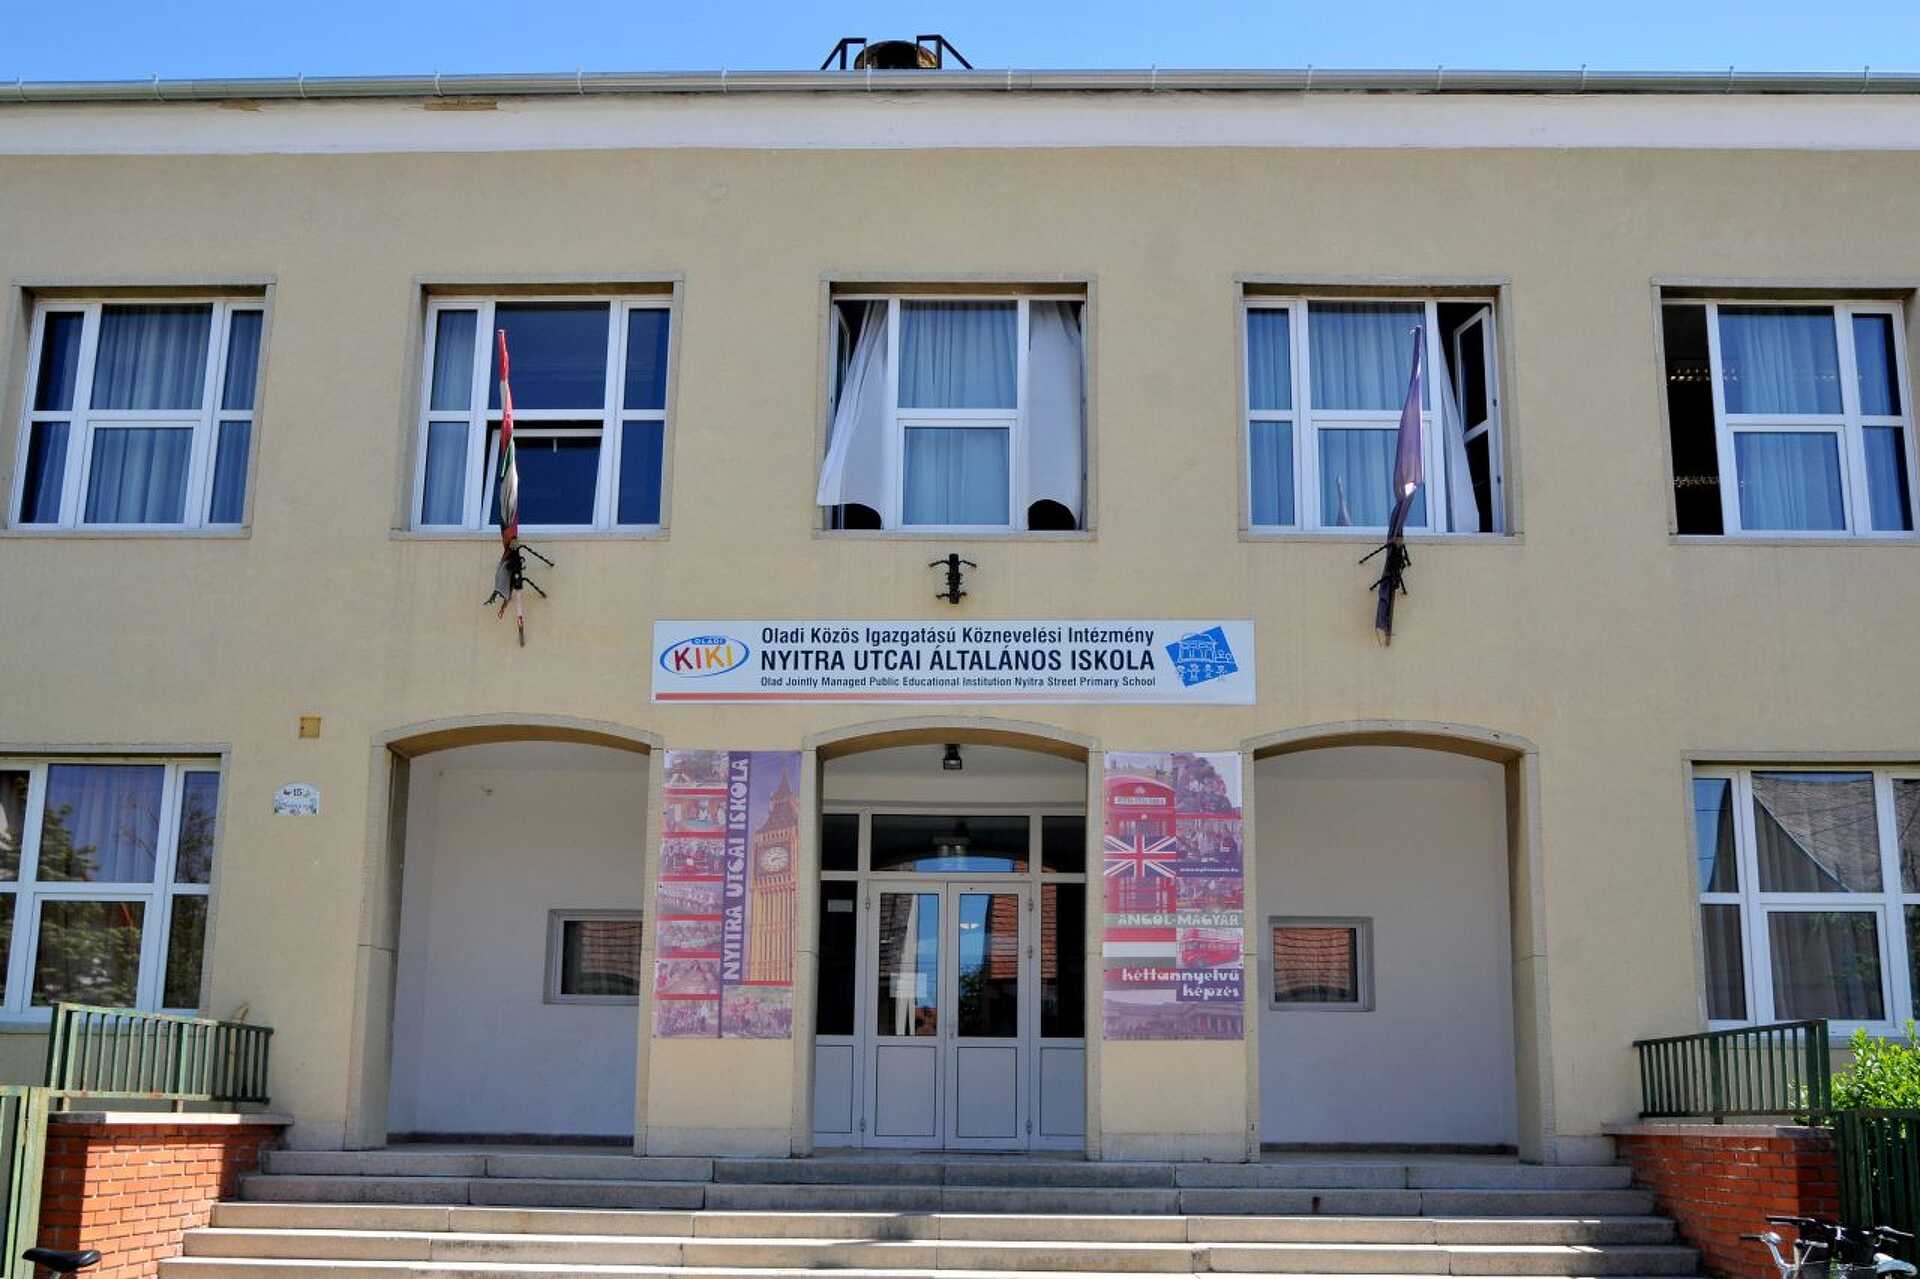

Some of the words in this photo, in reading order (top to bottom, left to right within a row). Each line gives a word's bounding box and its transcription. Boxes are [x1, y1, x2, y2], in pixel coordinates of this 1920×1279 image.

[762, 627, 804, 644] Oladi
[811, 627, 859, 644] Közös
[866, 626, 955, 647] Igazgatású
[962, 626, 1062, 643] Köznevelési
[1069, 626, 1154, 646] Intézmény
[674, 644, 734, 671] KIKI
[761, 650, 845, 670] NYITRA
[854, 650, 920, 671] UTCAI
[929, 645, 1061, 671] ÁLTALÁNOS
[1071, 650, 1155, 671] ISKOLA
[761, 677, 783, 687] Olad
[785, 677, 818, 688] Jointly
[822, 677, 866, 688] Managed
[869, 677, 899, 687] Public
[902, 677, 959, 687] Educational
[962, 677, 1012, 687] Institution
[1014, 677, 1044, 688] Nyitra
[1047, 677, 1077, 687] Street
[1080, 677, 1119, 688] Primary
[1122, 677, 1156, 687] School
[730, 758, 749, 830] ISKOLA
[726, 837, 745, 897] UTCAI
[1118, 913, 1239, 926] ANGOL-MAGYAR
[723, 905, 743, 980] NYITRA
